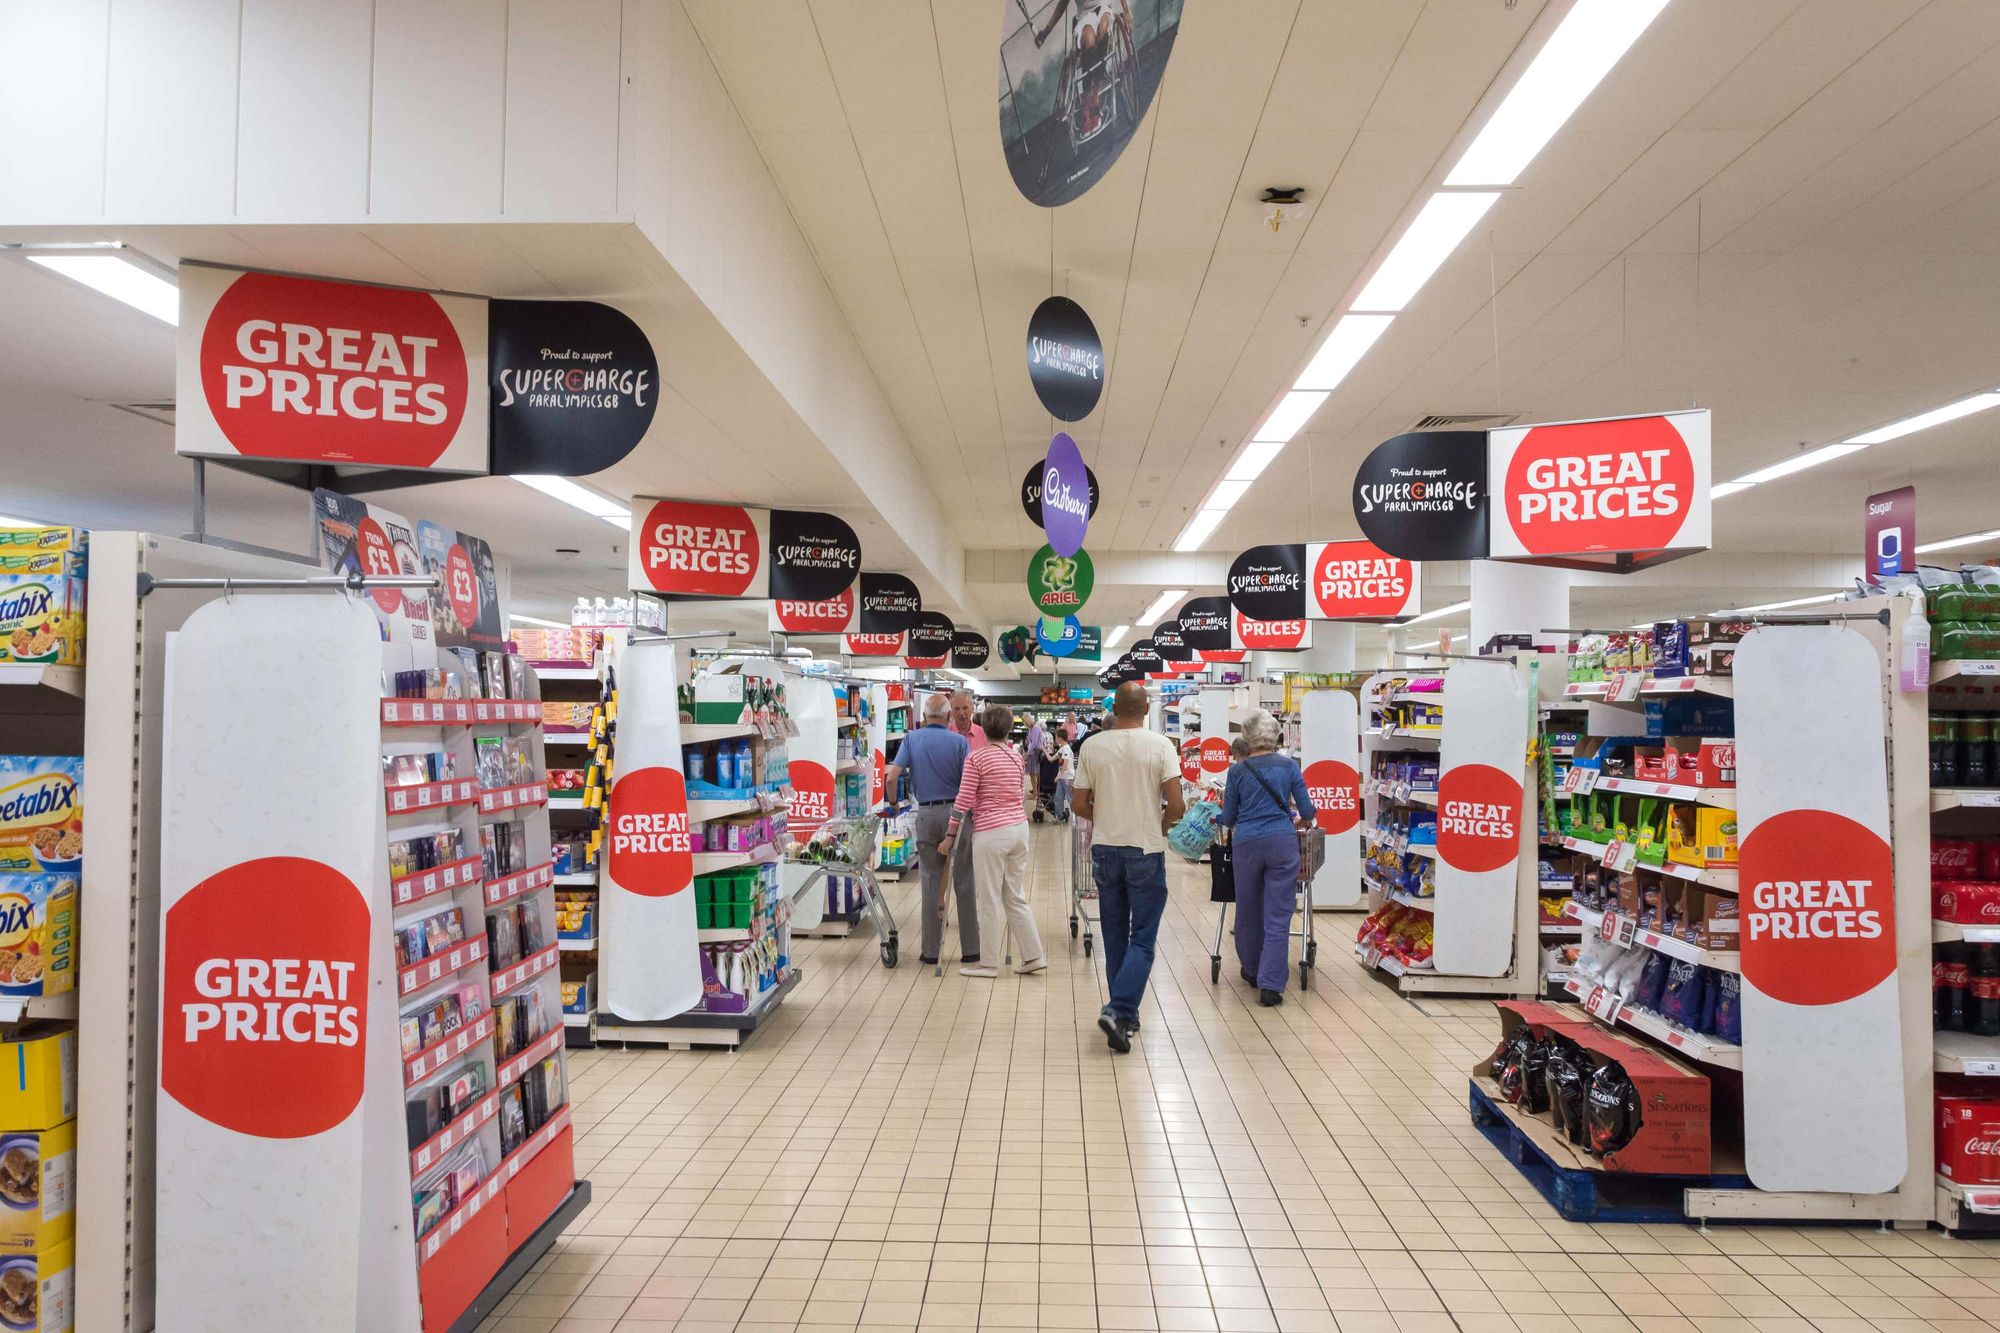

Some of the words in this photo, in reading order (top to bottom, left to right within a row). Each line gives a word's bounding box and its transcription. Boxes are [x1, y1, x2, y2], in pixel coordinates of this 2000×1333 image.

[236, 318, 439, 379] GREAT
[540, 348, 570, 360] Proud
[572, 351, 580, 360] to
[581, 350, 614, 363] support
[1032, 336, 1099, 380] SUPERCHARGE
[222, 364, 448, 426] PRICES
[499, 368, 650, 407] SUPERCHARGE
[528, 393, 619, 409] PARALYMPICSGB
[1390, 468, 1413, 478] Proud
[1422, 468, 1447, 478] support
[1526, 448, 1670, 490] GREAT
[1044, 467, 1087, 524] Cadbury
[1360, 481, 1477, 513] SUPERCHARGE
[1384, 500, 1454, 512] PARALYMPICSGB
[1518, 483, 1679, 523] PRICES
[1869, 500, 1893, 516] Sugar
[655, 523, 746, 551] GREAT
[649, 546, 750, 574] PRICES
[777, 545, 857, 568] SUPERCHARGE
[1325, 558, 1400, 580] GREAT
[453, 569, 472, 603] £3
[1231, 574, 1300, 594] SUPERCHARGE
[1320, 578, 1405, 600] PRICES
[864, 596, 918, 612] SUPERCHARGE
[1041, 591, 1080, 605] ARIEL
[782, 600, 848, 618] PRICES
[1179, 616, 1228, 632] SUPERCHARGE
[1242, 622, 1301, 636] PRICES
[850, 634, 900, 645] PRICES
[794, 790, 828, 806] REAT
[1308, 787, 1352, 798] GREAT
[786, 804, 828, 818] RICES
[1444, 801, 1512, 822] GREAT
[617, 813, 688, 834] GREAT
[1441, 816, 1514, 839] PRICES
[614, 833, 691, 854] PRICES
[1753, 880, 1872, 909] GREAT
[1748, 910, 1882, 941] PRICES
[194, 958, 355, 1000] GREAT
[182, 1002, 358, 1046] PRICES
[1961, 1109, 1972, 1117] 18
